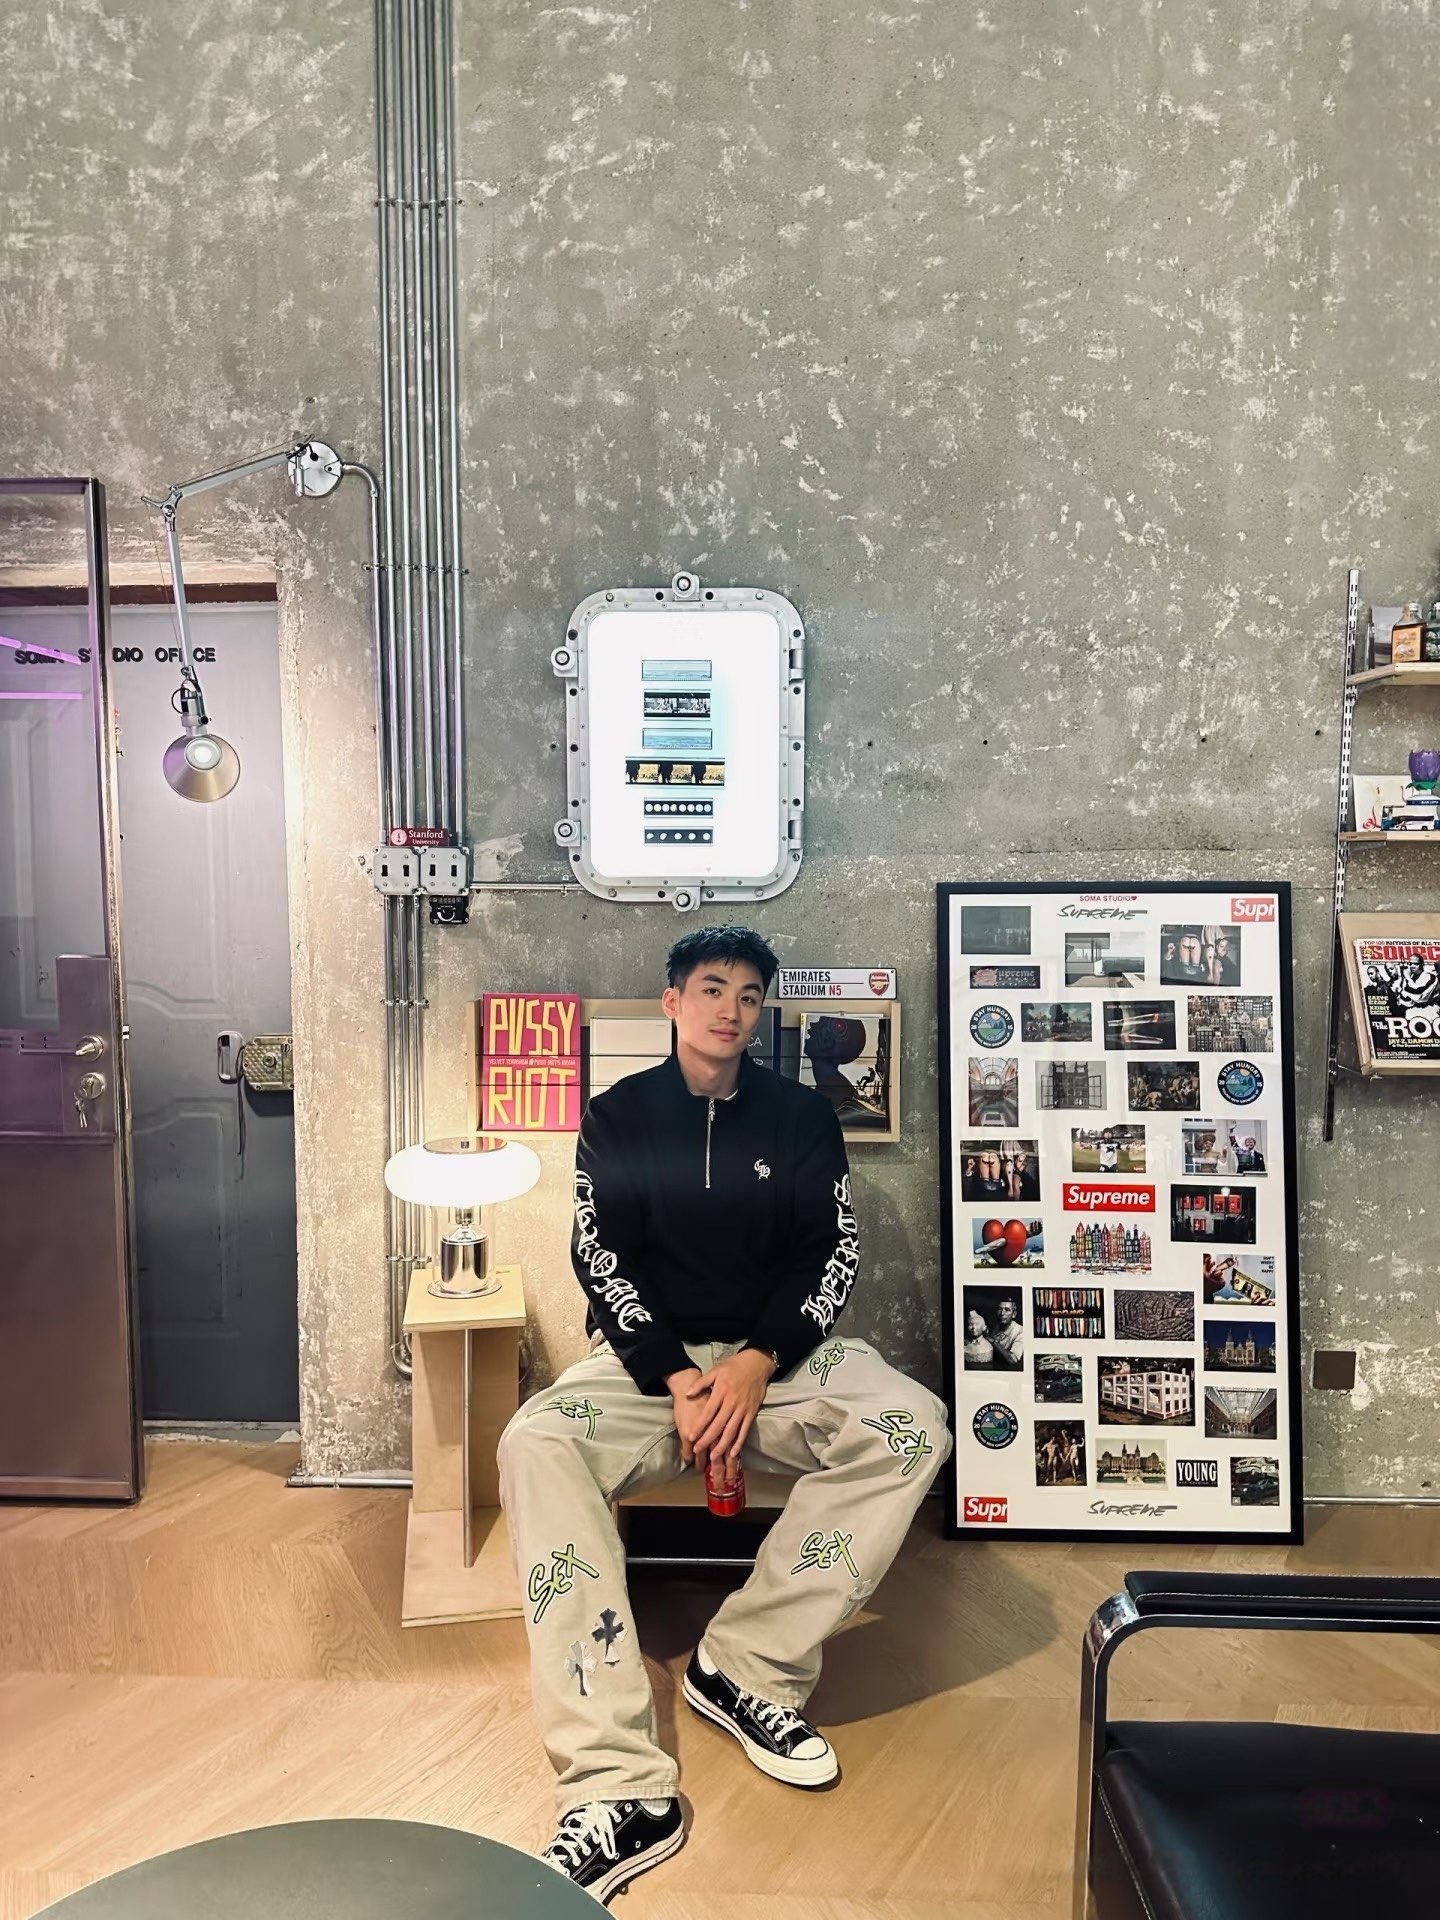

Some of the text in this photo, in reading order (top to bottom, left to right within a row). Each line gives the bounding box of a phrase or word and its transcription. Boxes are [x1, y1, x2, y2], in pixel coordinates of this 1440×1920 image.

[78, 648, 144, 663] SDIO
[155, 648, 217, 663] OFCE
[409, 830, 444, 839] Stanford
[412, 839, 440, 847] University
[1058, 904, 1148, 920] SUPREME
[1233, 899, 1275, 922] Supr
[783, 971, 831, 982] EMIRATES
[783, 984, 842, 996] STADIUM N5
[973, 1006, 1011, 1022] STAY HUNGRY
[489, 998, 577, 1060] PUSSY
[1221, 1062, 1261, 1078] STAY HUNGRY
[488, 1066, 577, 1129] RIOT
[1067, 1185, 1151, 1210] Supreme
[976, 1404, 1015, 1420] STAY HUNGRY
[861, 1410, 932, 1476] SEX
[1177, 1462, 1217, 1482] YOUNG
[966, 1497, 1008, 1522] Supr
[1087, 1501, 1178, 1517] SUPREME
[791, 1530, 859, 1577] SEX
[528, 1543, 600, 1624] SEX
